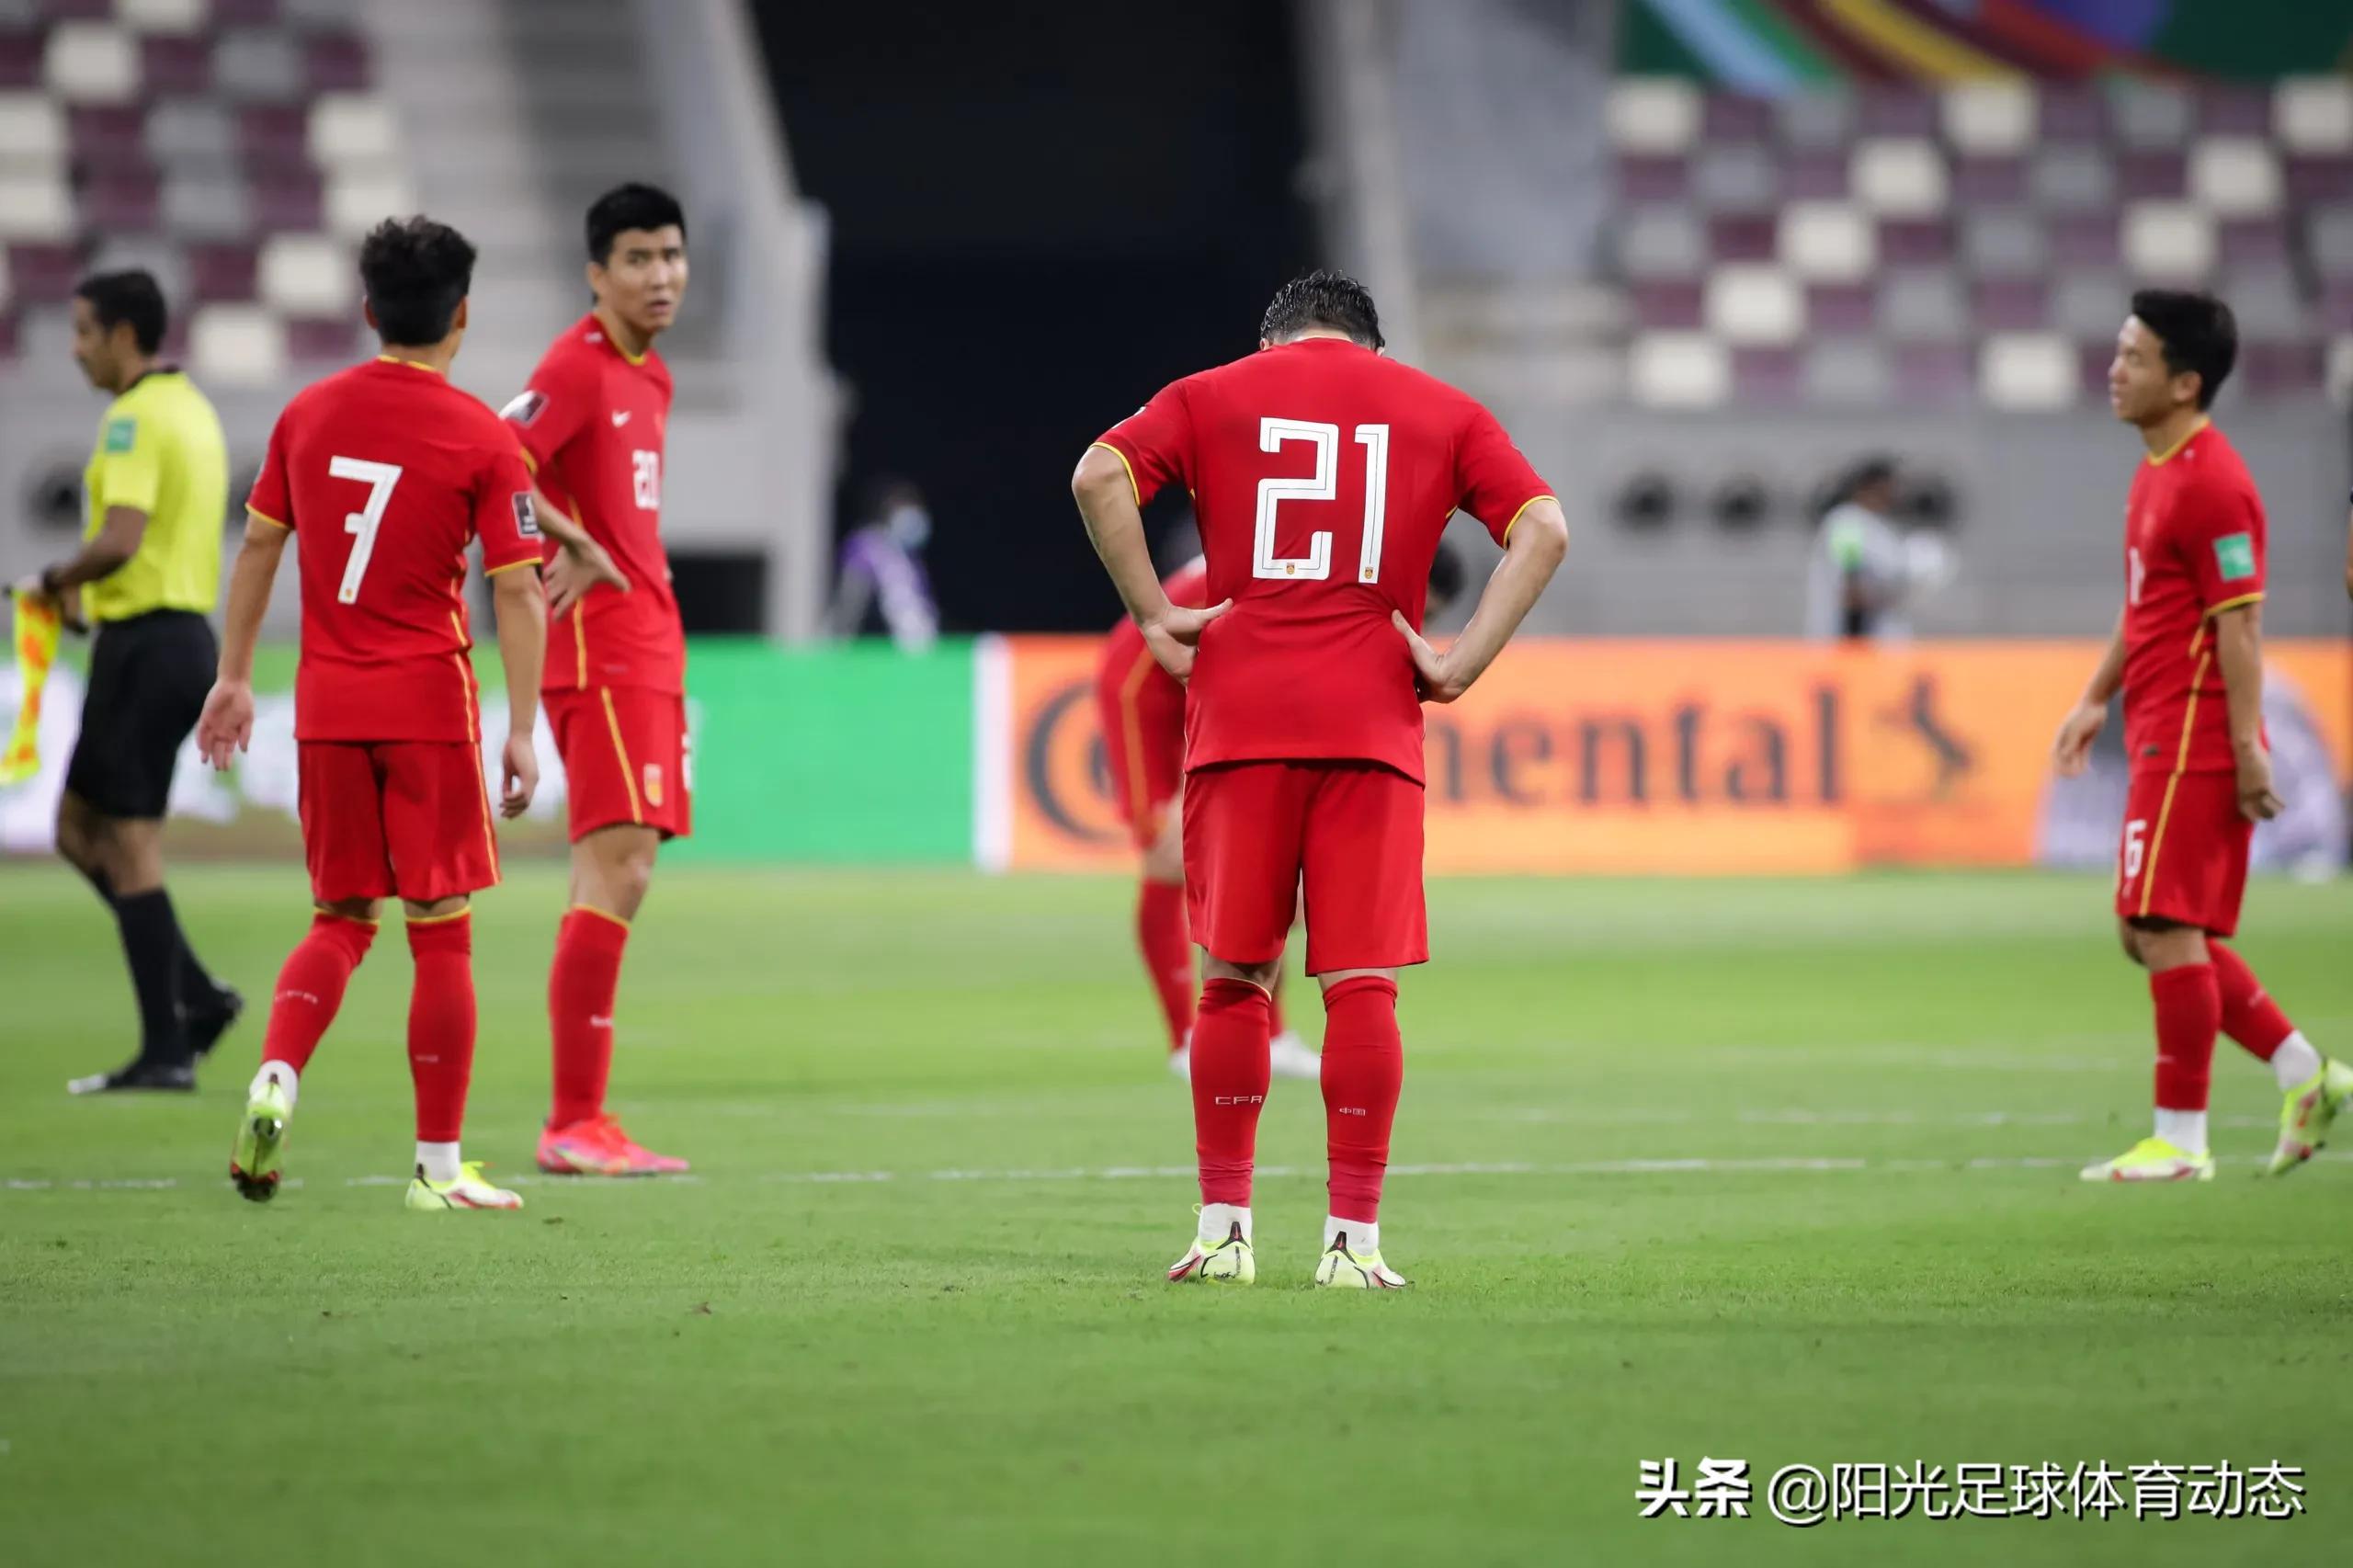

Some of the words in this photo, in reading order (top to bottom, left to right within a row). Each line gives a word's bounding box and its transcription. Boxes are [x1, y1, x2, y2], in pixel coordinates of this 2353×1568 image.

[328, 455, 404, 605] 7
[1253, 416, 1390, 585] 21
[2125, 819, 2147, 879] 6
[1215, 1095, 1263, 1105] CFA
